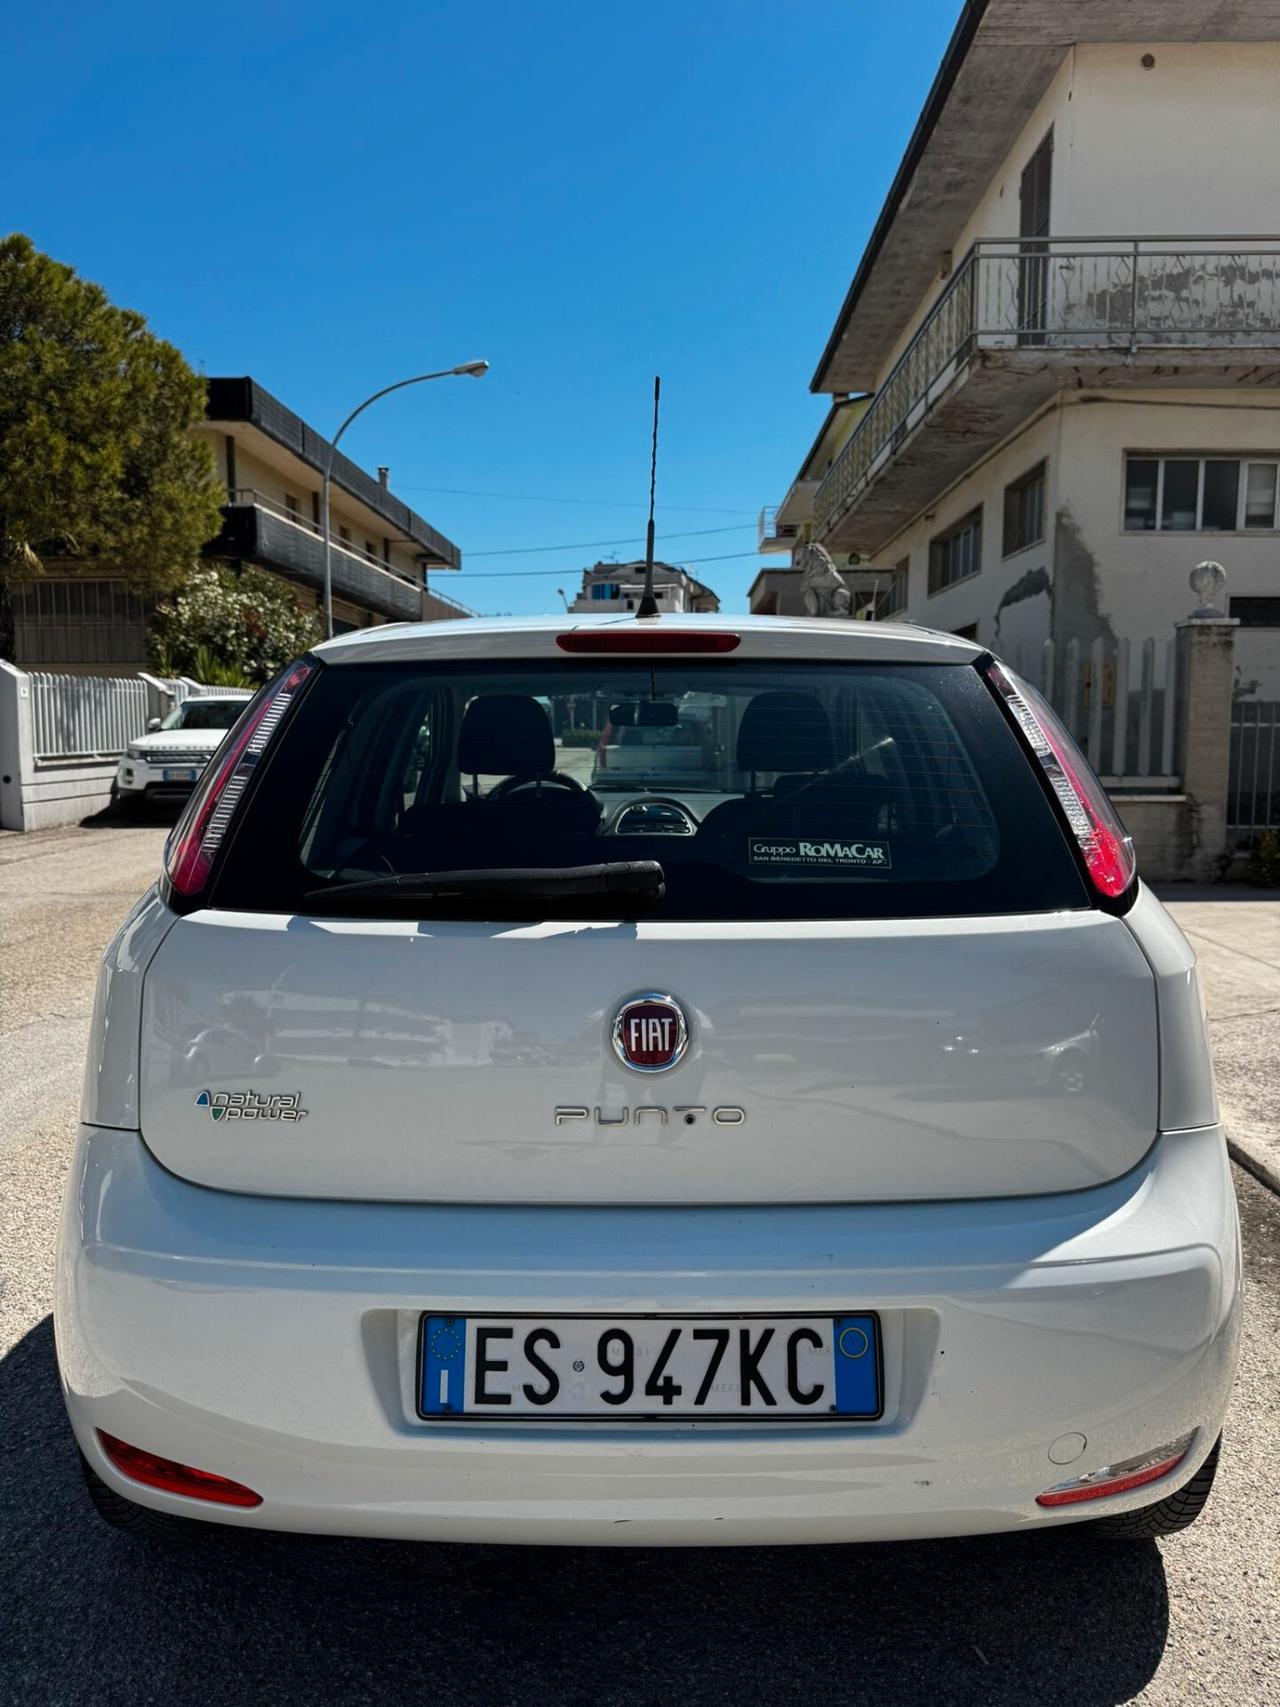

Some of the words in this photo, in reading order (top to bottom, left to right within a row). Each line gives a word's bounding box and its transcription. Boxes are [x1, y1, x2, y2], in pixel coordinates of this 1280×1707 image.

[753, 843, 796, 856] Gruppo
[630, 1017, 673, 1052] FIAT
[213, 1088, 300, 1108] natural
[225, 1106, 308, 1121] power
[554, 1106, 746, 1126] PUNTO
[474, 1327, 561, 1406] ES
[597, 1327, 825, 1407] 947KC
